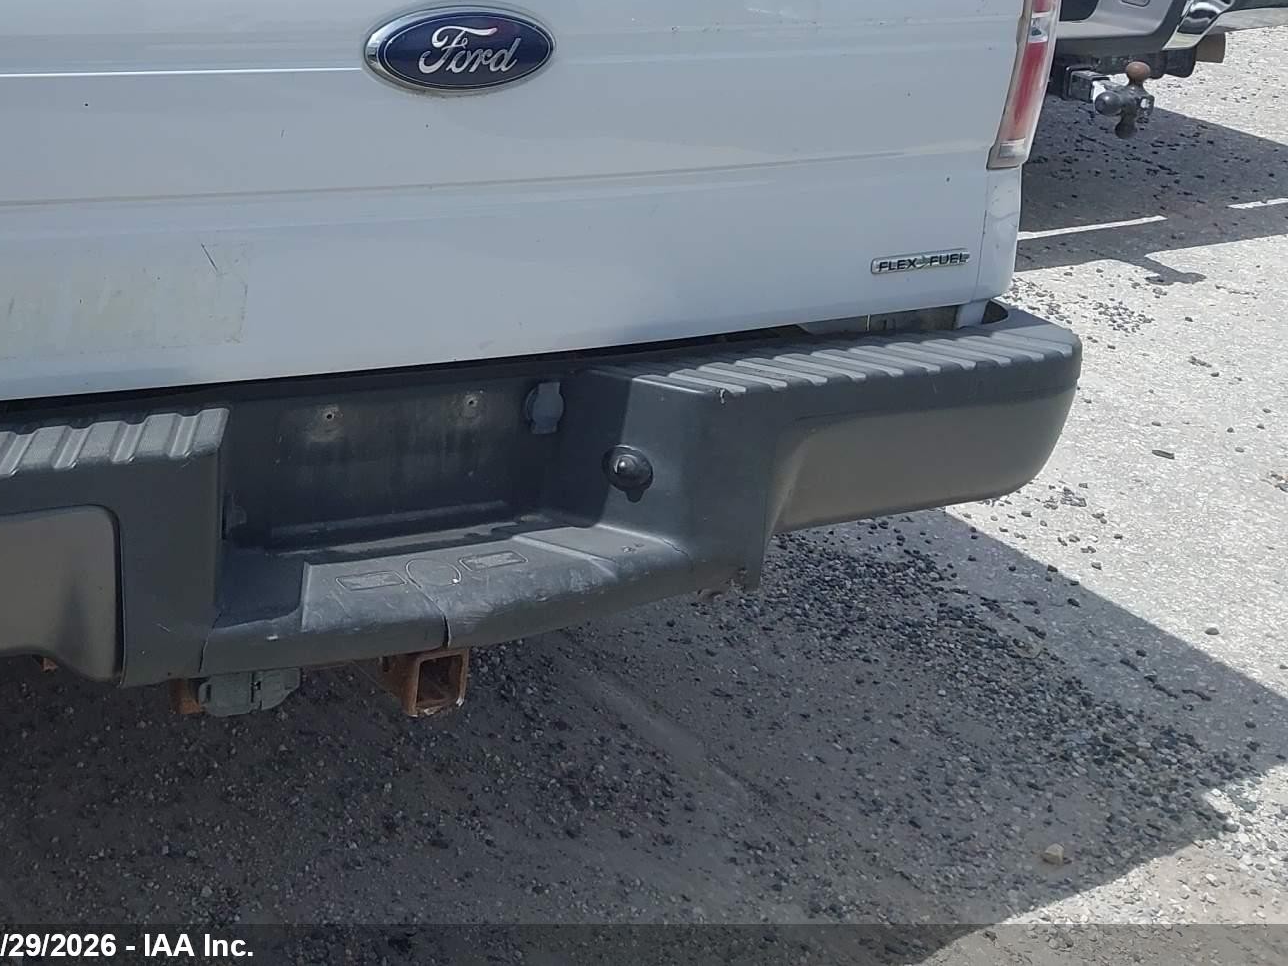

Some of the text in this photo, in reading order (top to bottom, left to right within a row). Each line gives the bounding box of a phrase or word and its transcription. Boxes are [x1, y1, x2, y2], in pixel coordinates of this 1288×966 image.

[418, 25, 522, 74] Ford
[878, 253, 969, 272] FLEX FUEL
